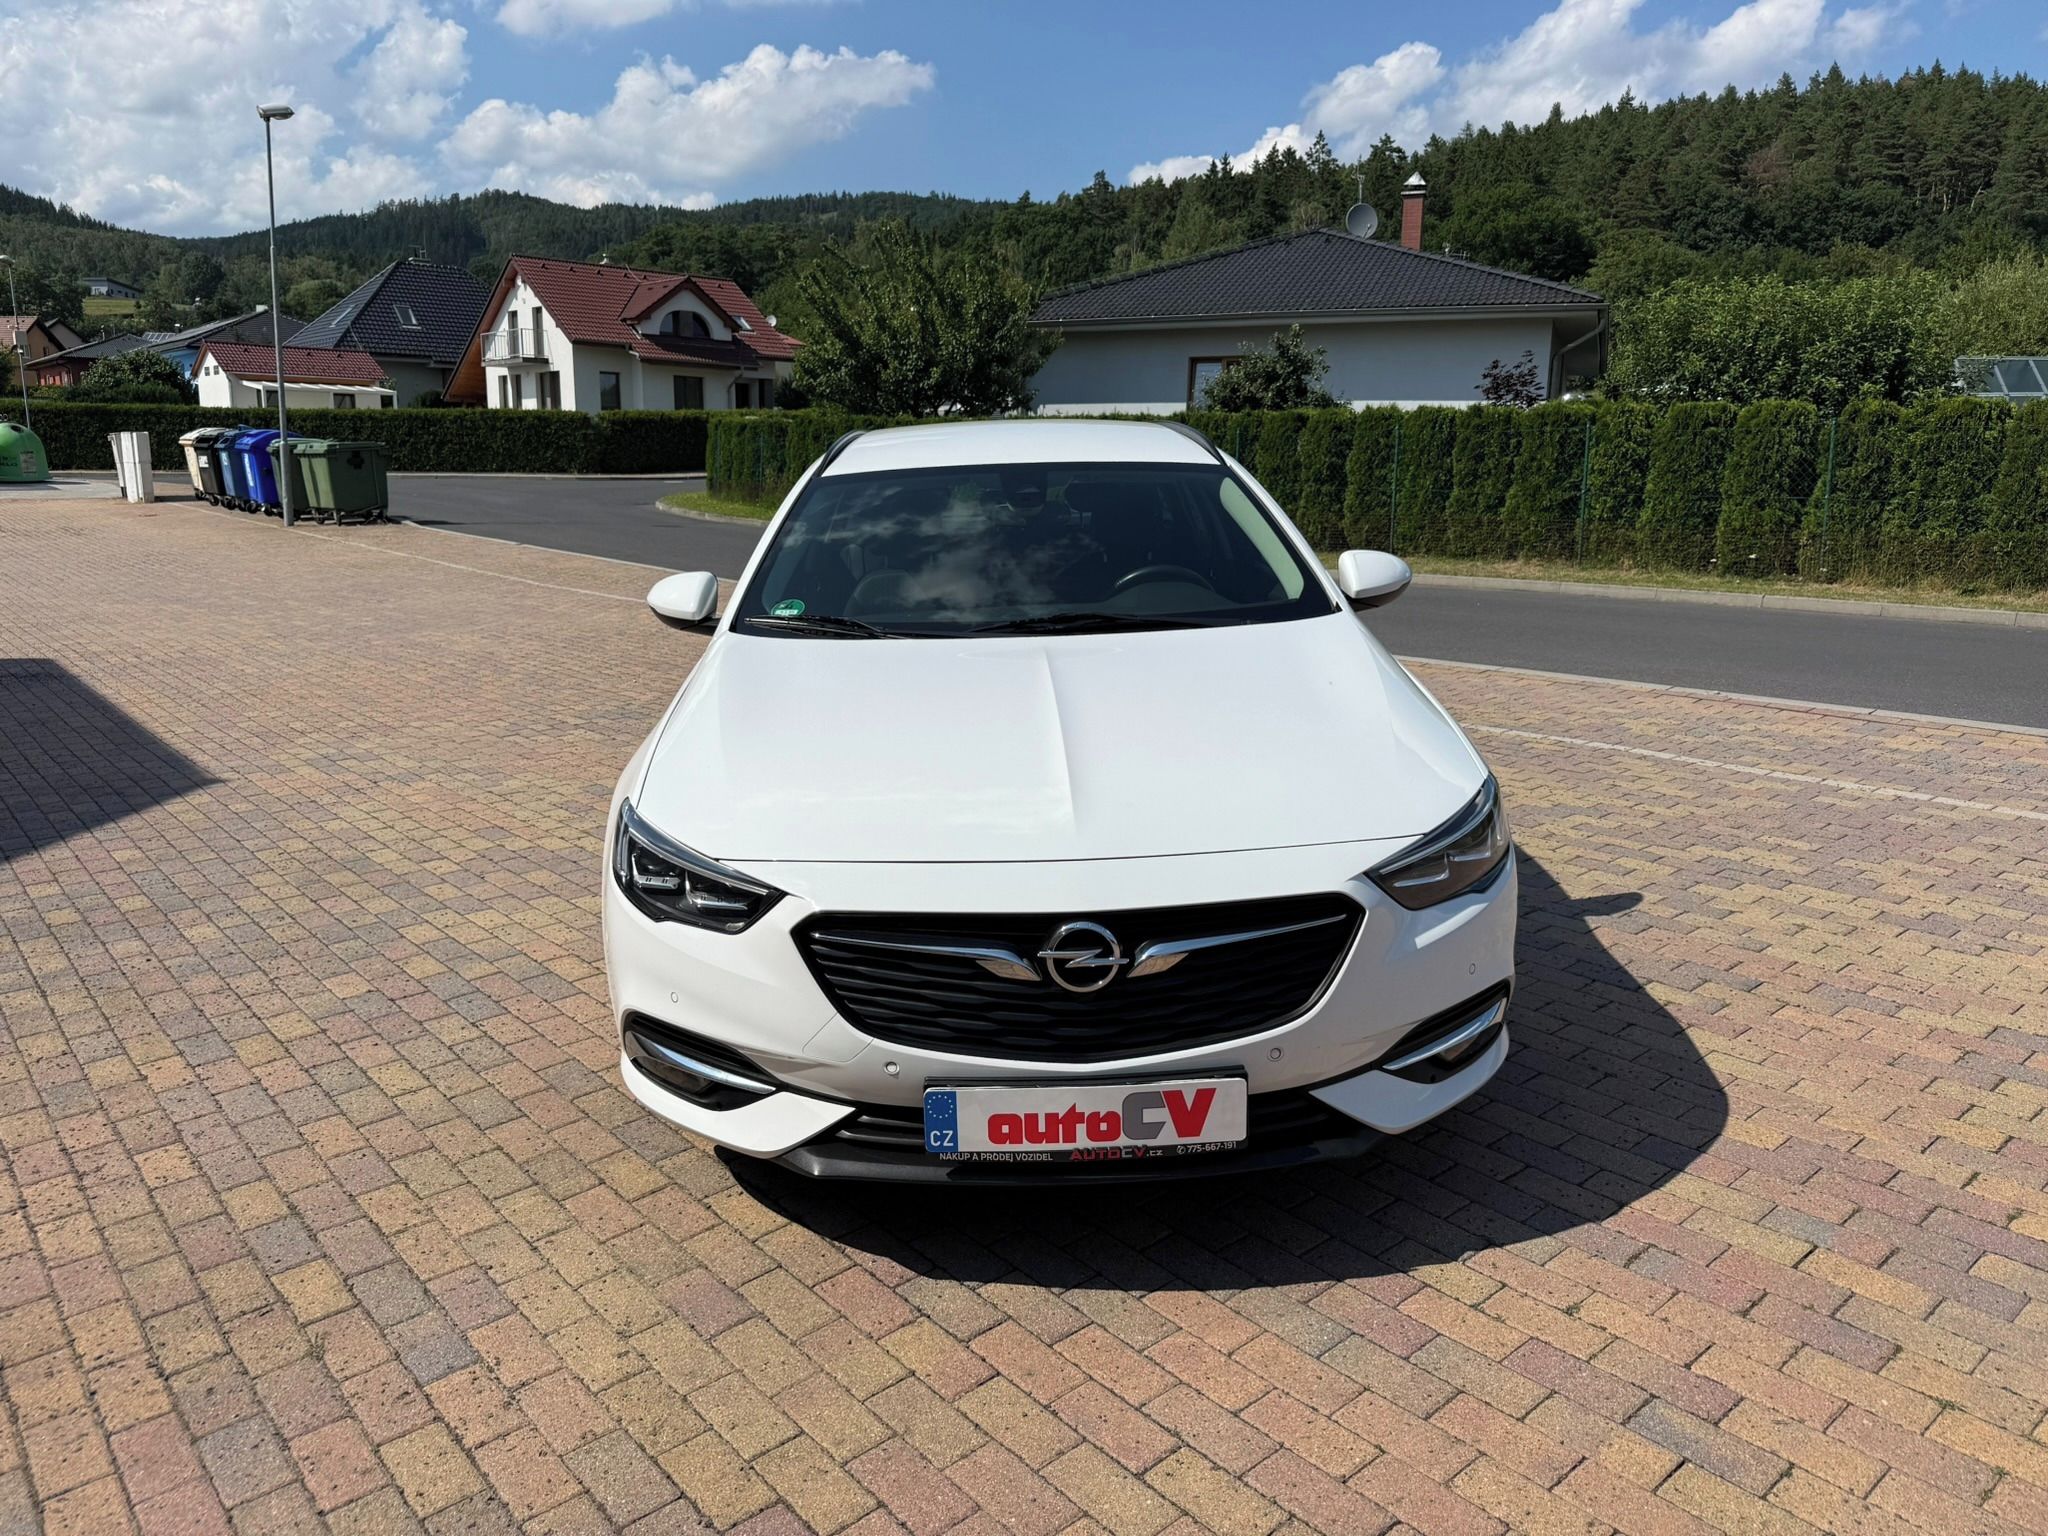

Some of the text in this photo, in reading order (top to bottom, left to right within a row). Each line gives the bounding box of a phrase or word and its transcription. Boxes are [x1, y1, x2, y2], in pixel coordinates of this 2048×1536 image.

[988, 1088, 1216, 1145] autoCV
[930, 1130, 954, 1147] CZ
[1187, 1142, 1237, 1153] 775-667-191
[972, 1153, 979, 1161] A
[980, 1153, 1014, 1162] PRODEJ
[1016, 1153, 1053, 1161] VOZIDEL
